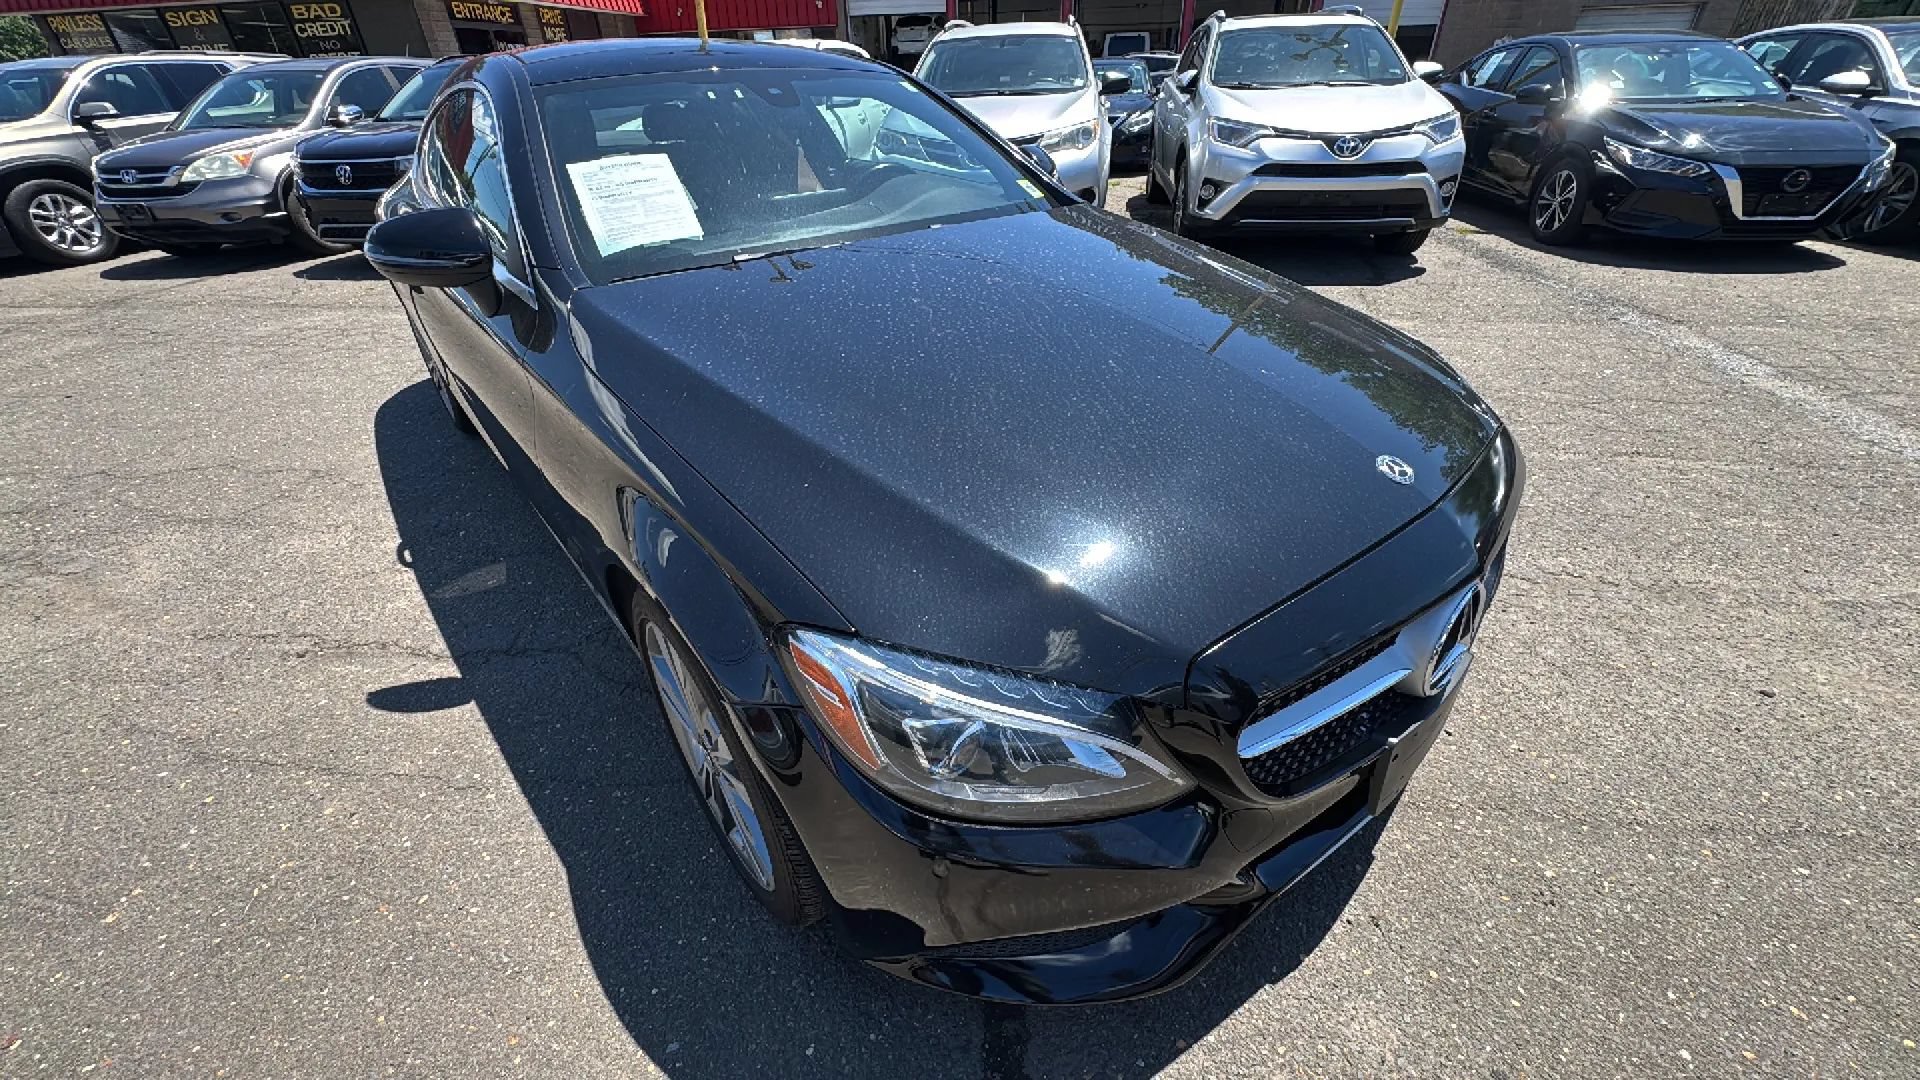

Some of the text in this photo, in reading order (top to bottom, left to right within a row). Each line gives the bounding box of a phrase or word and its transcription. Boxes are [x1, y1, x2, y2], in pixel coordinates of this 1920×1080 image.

[165, 9, 218, 26] SIGN
[290, 4, 341, 18] BAD
[451, 2, 514, 23] ENTRANCE
[539, 8, 564, 24] DRIVE
[47, 14, 106, 32] PAYLESS
[295, 20, 351, 37] CREDIT
[193, 27, 206, 41] &
[60, 36, 114, 49] CAR SALES
[320, 40, 340, 50] NO
